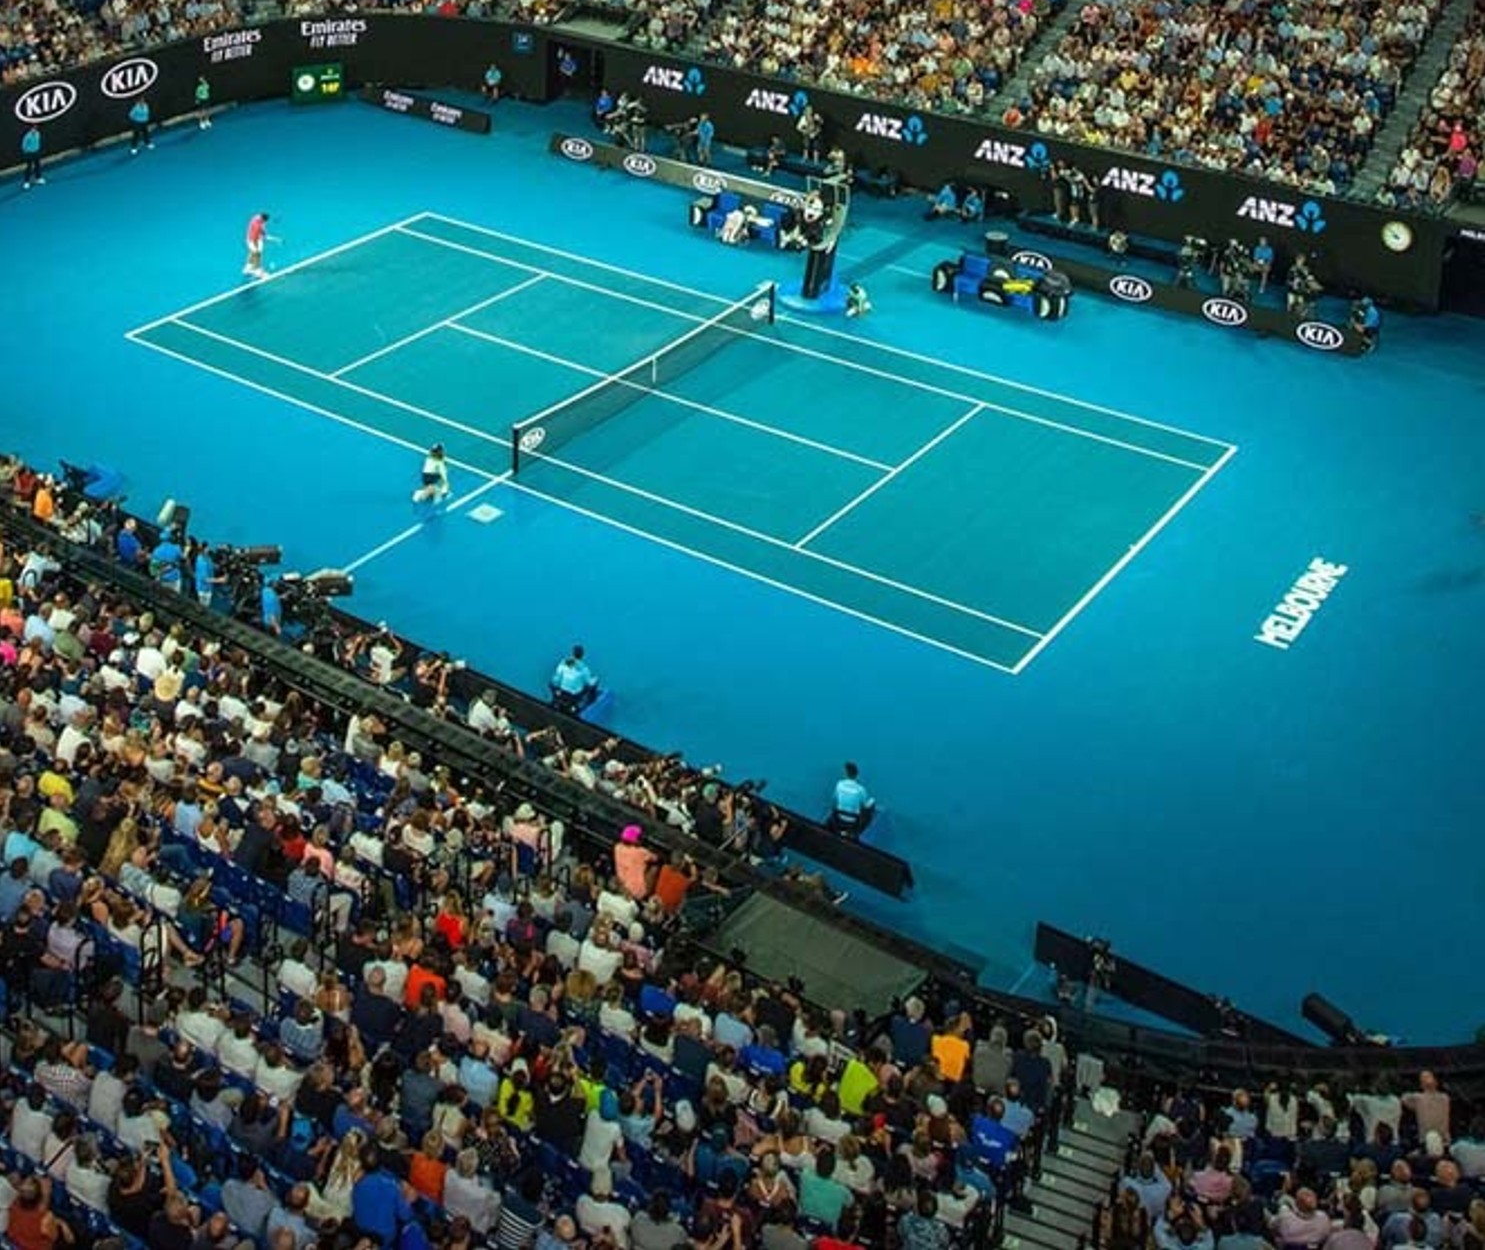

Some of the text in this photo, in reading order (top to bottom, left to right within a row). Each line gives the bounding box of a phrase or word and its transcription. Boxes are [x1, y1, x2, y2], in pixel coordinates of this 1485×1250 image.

[203, 29, 262, 52] Emirates
[301, 19, 367, 36] Emirates
[112, 65, 149, 92] KIA
[642, 65, 684, 92] ANZ
[26, 88, 66, 117] KIA
[744, 88, 790, 115] ANZ
[855, 113, 903, 141] ANZ
[974, 139, 1026, 168] ANZ
[1100, 166, 1156, 197] ANZ
[1236, 196, 1296, 228] ANZ
[1116, 280, 1145, 299] KIA
[1210, 303, 1241, 322] KIA
[1304, 326, 1334, 346] KIA
